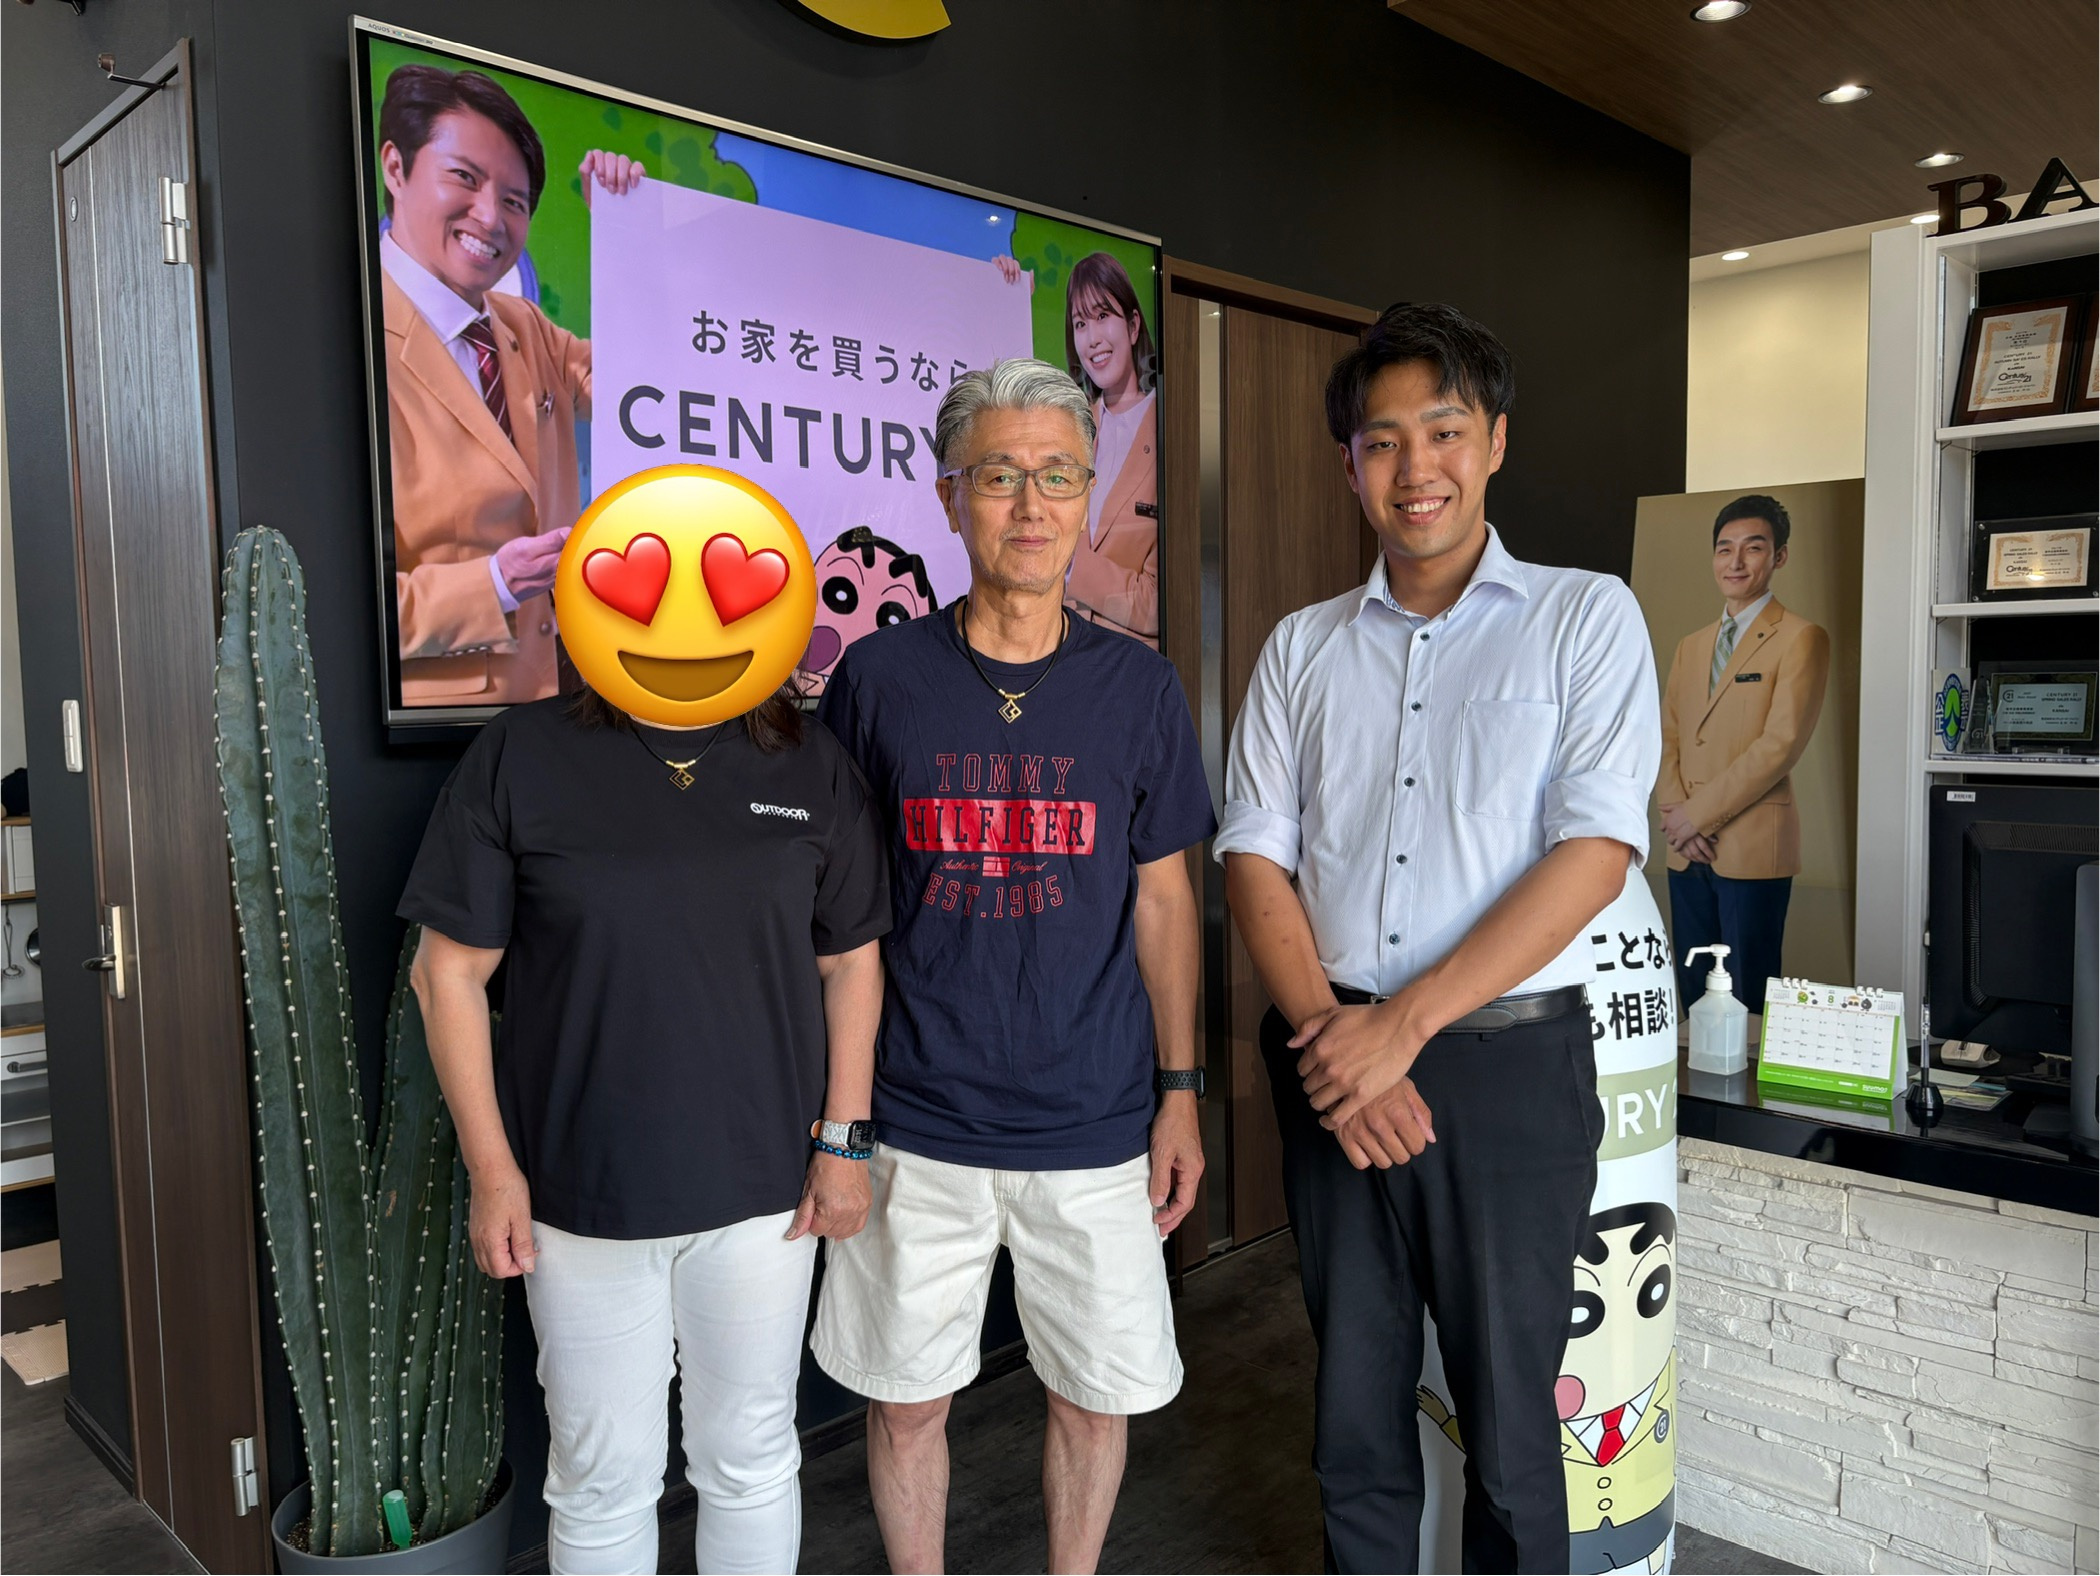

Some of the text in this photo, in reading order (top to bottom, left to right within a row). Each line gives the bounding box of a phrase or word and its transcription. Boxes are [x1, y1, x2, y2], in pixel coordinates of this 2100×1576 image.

[368, 23, 390, 33] AQUOS
[936, 753, 1075, 795] TOMMY
[750, 803, 809, 821] OUTDOOR
[909, 805, 1086, 847] HILFIGER
[940, 859, 1048, 875] Authentic Original
[922, 872, 1064, 919] EST.1985
[1828, 995, 1834, 1004] 8
